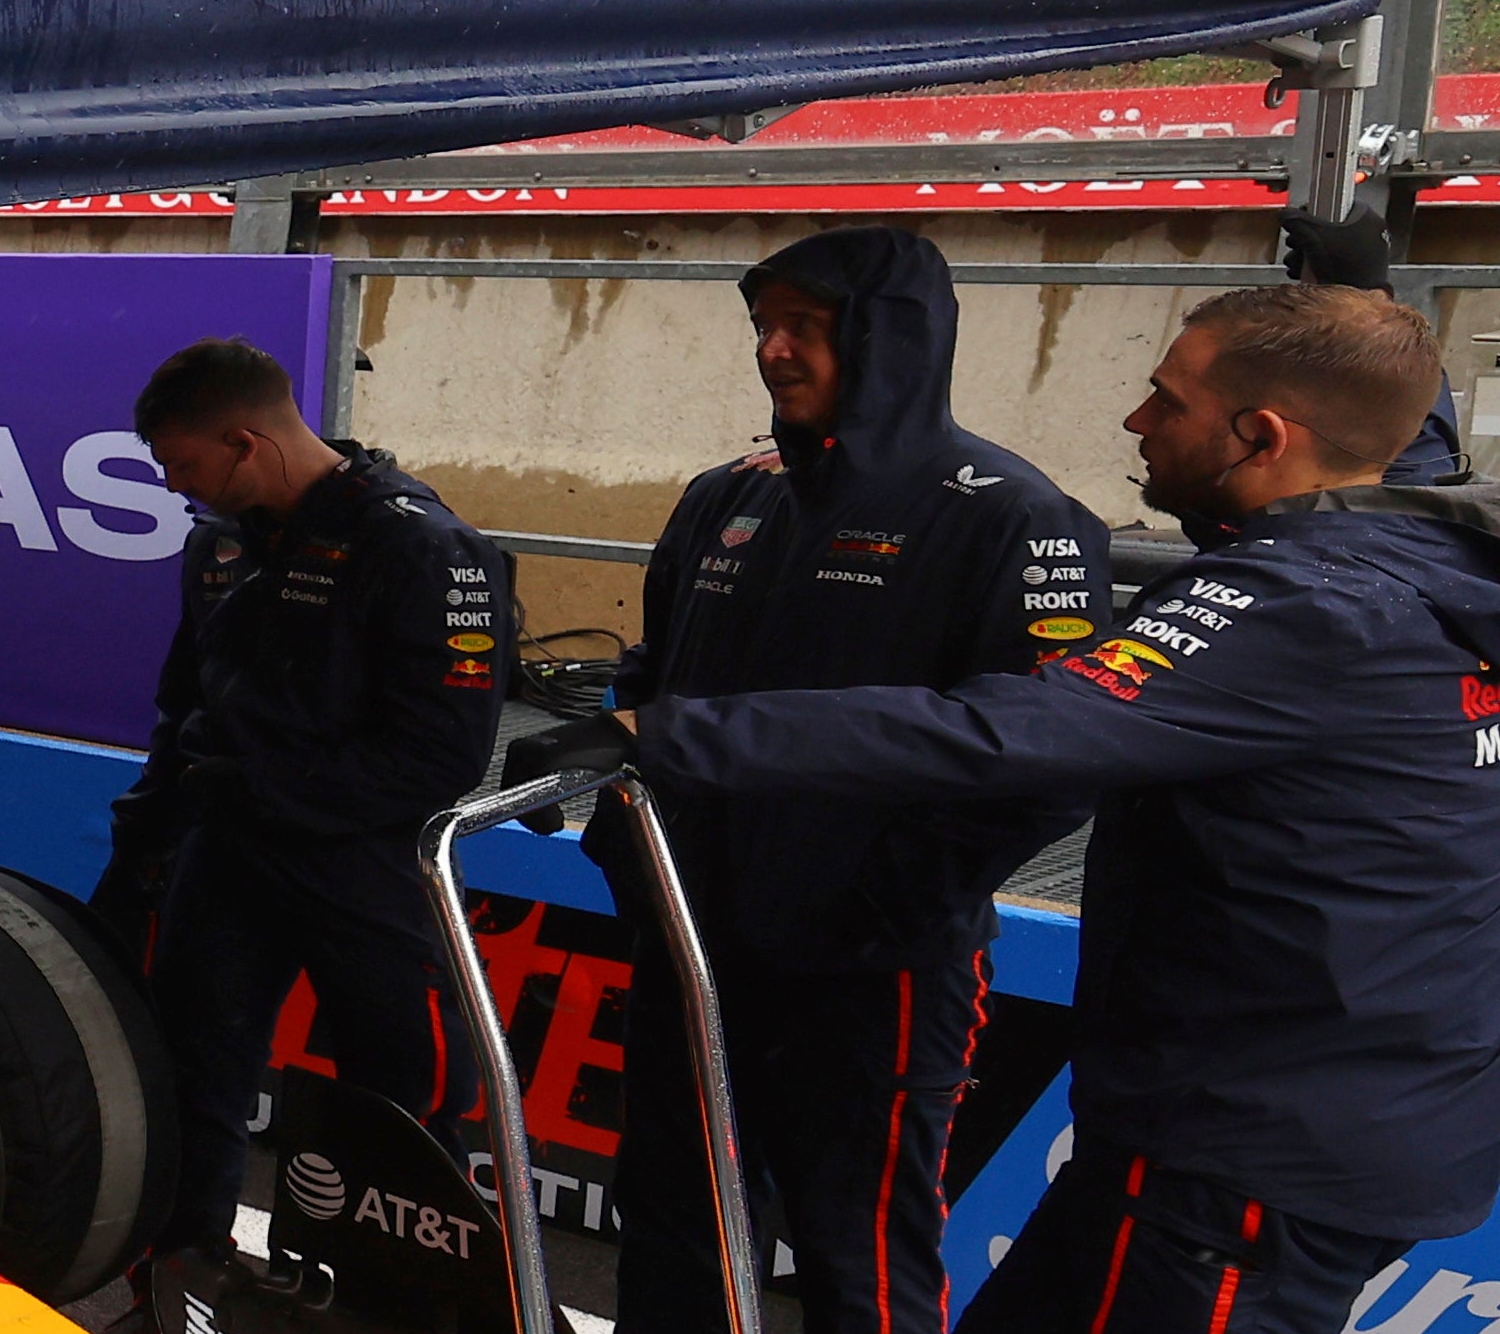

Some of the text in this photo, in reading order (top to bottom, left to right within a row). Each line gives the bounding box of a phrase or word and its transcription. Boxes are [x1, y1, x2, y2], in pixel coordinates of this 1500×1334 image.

[1027, 539, 1081, 557] VISA
[447, 568, 487, 583] VISA
[816, 569, 885, 586] HONDA
[1050, 567, 1086, 581] AT&T
[465, 591, 490, 603] AT&T
[1024, 591, 1090, 610] ROKT
[1194, 577, 1256, 610] VISA
[446, 611, 492, 627] ROKT
[1180, 604, 1233, 632] AT&T
[1126, 616, 1210, 657] ROKT
[353, 1186, 481, 1260] AT&T
